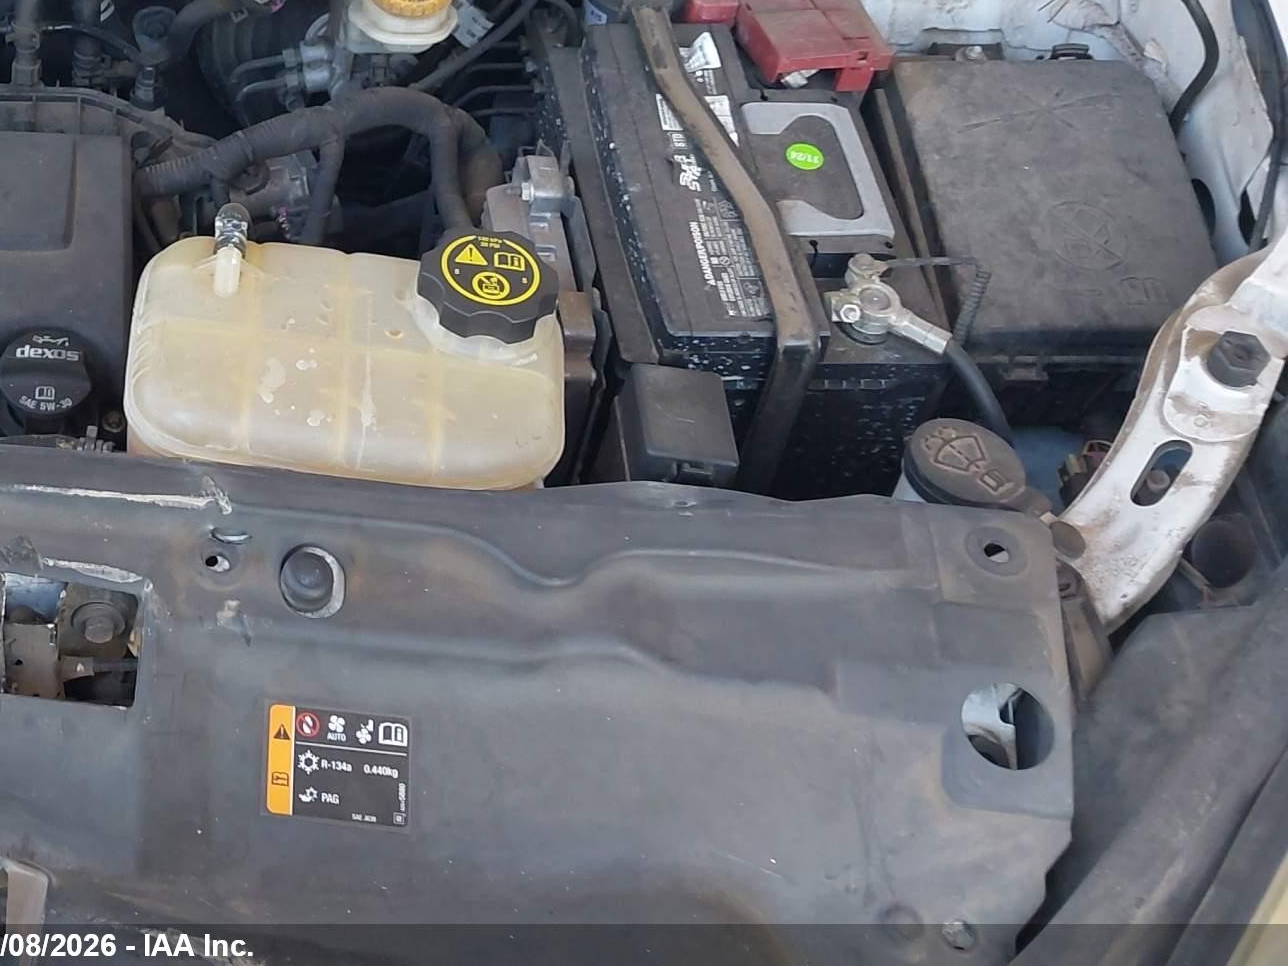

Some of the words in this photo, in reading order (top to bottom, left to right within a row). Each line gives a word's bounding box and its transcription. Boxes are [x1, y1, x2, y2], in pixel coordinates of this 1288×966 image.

[15, 344, 81, 362] dexos
[18, 395, 37, 410] SAE
[39, 397, 73, 412] 5W-30
[327, 732, 347, 742] AUTO
[320, 759, 353, 773] R-134a
[363, 764, 399, 779] 0.440kg
[321, 792, 340, 804] PAG
